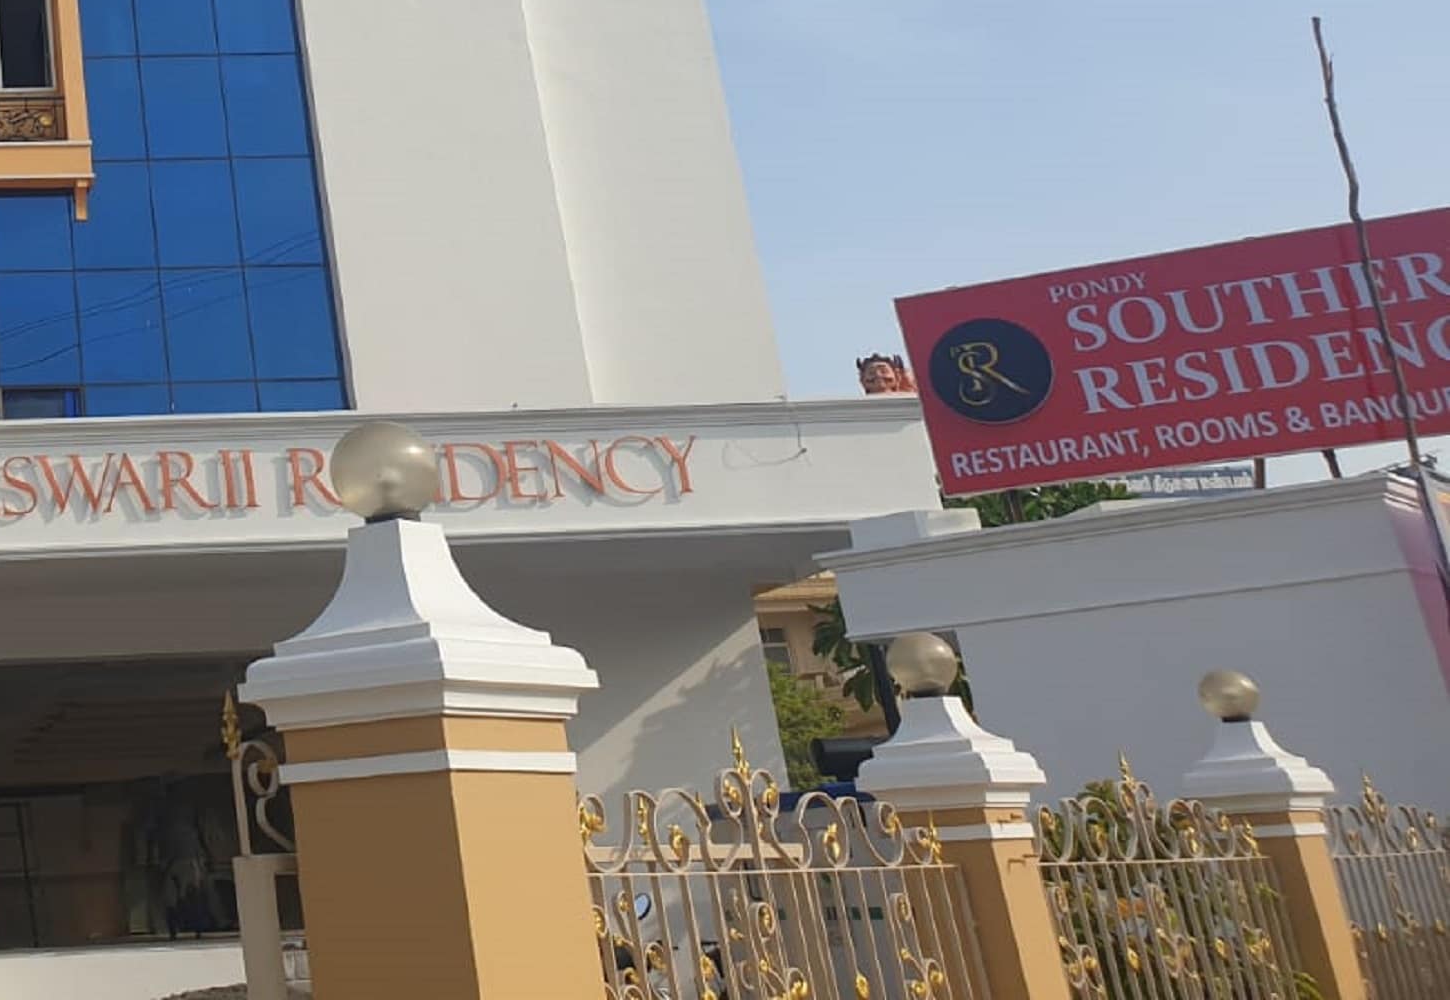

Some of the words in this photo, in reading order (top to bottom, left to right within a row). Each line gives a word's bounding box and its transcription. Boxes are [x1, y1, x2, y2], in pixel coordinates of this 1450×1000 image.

[1049, 272, 1146, 304] PONDY
[286, 434, 697, 507] RDENCY
[951, 428, 1150, 479] RESTAURANT,
[1155, 411, 1279, 450] ROOMS
[1285, 406, 1315, 433] &
